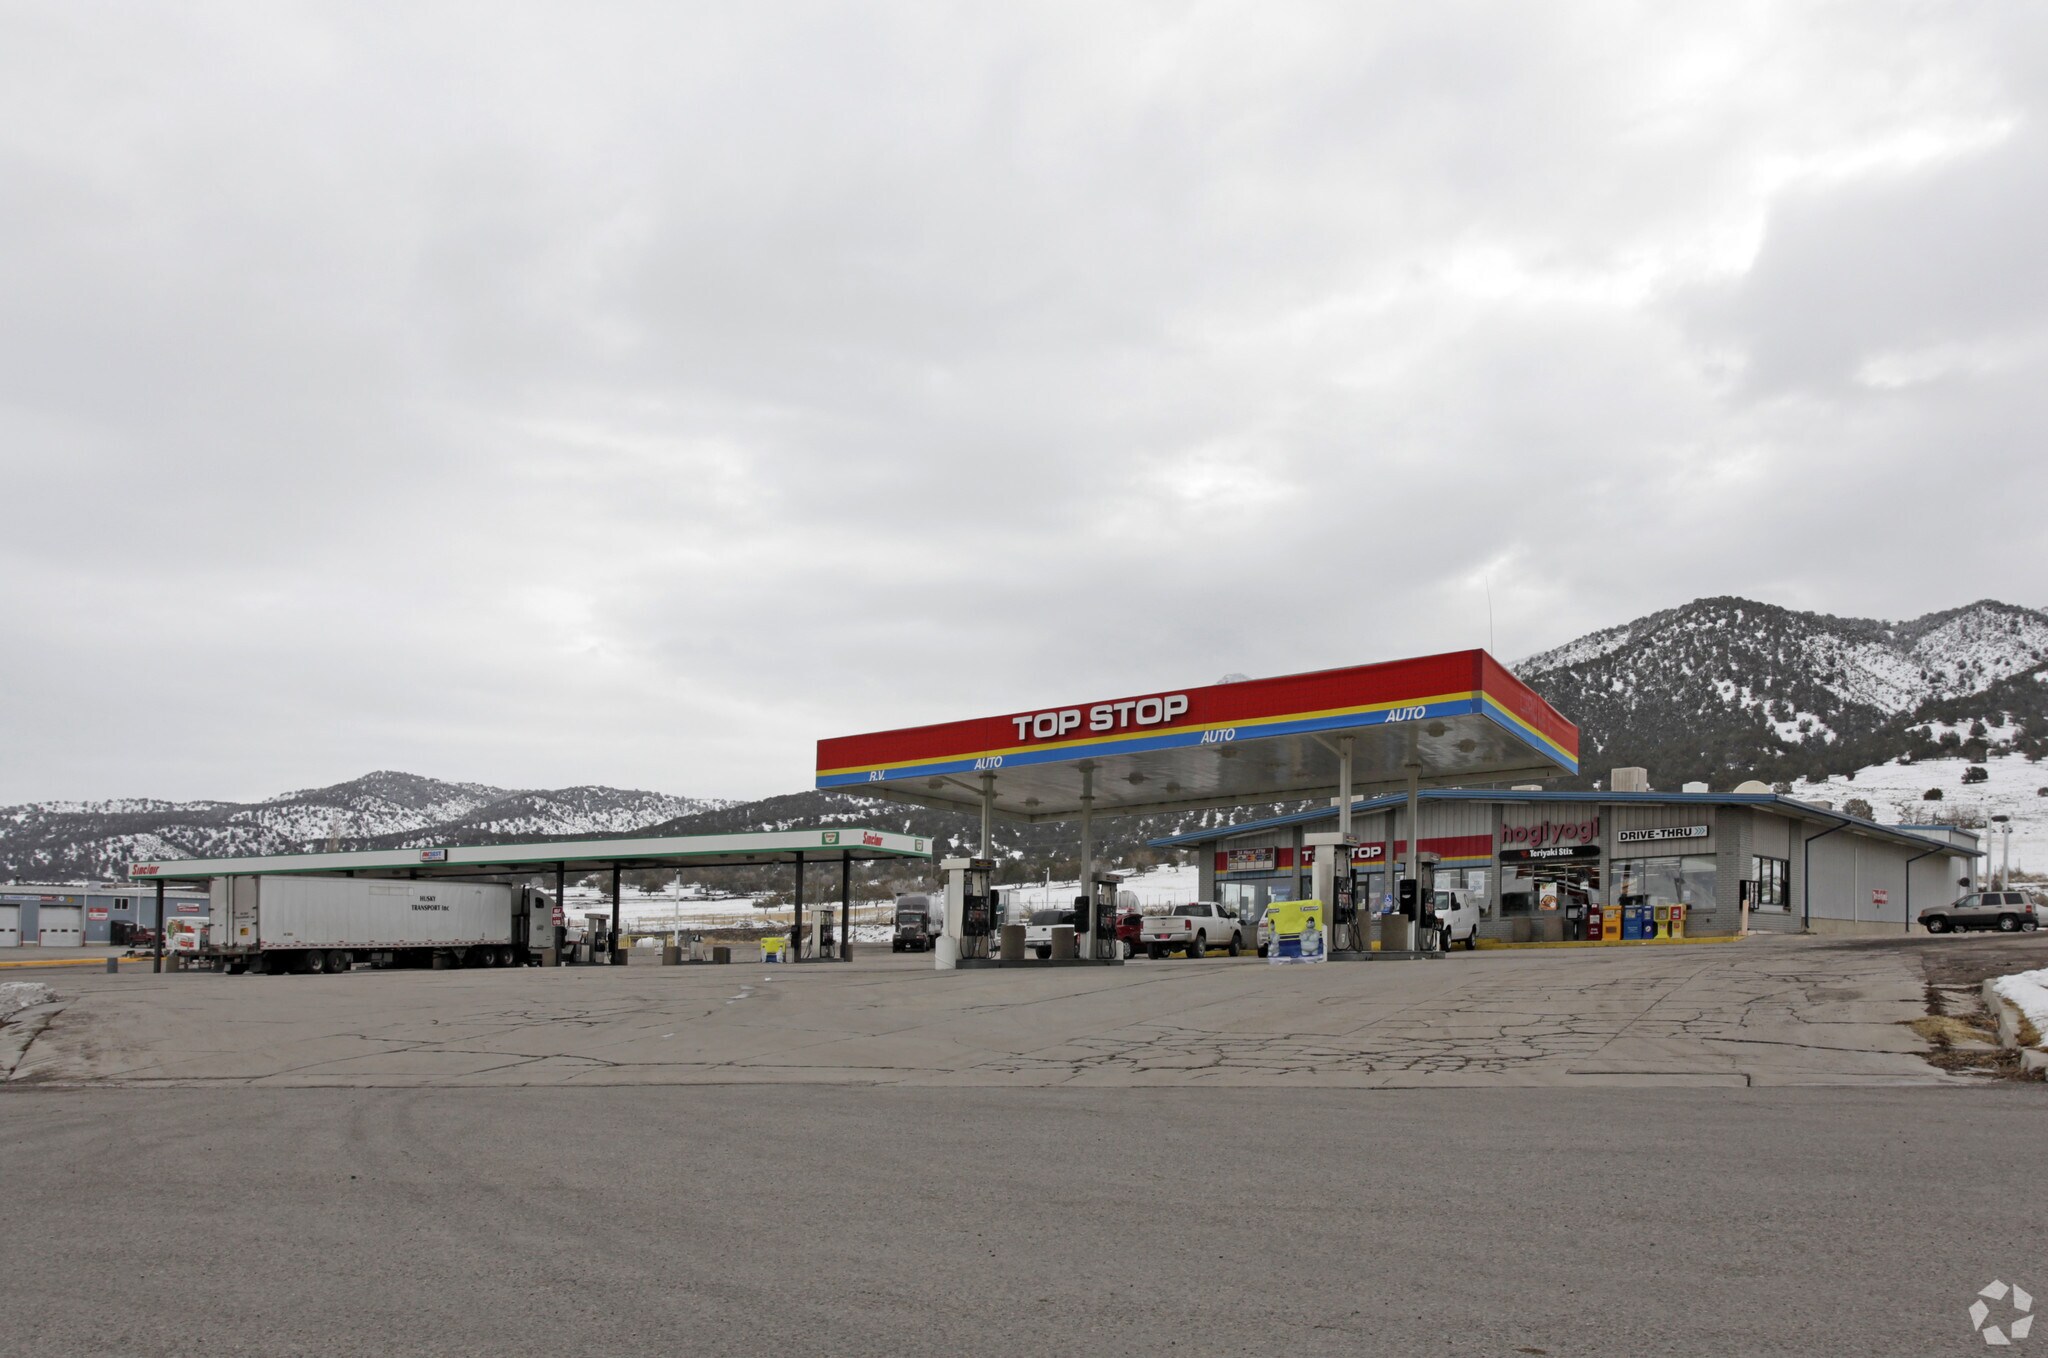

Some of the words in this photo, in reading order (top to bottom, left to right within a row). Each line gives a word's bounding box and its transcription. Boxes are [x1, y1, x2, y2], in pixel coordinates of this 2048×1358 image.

[1012, 709, 1081, 741] TOP
[1089, 694, 1188, 731] STOP
[1384, 705, 1426, 723] AUTO
[1200, 728, 1236, 744] AUTO
[973, 755, 1003, 770] AUTO
[869, 769, 885, 782] R.V.
[1500, 820, 1548, 847] hogi
[1549, 816, 1600, 845] yogi
[1620, 827, 1692, 841] DRIVE-THRU
[1351, 846, 1382, 859] TOP
[1530, 849, 1558, 859] Teriyaki
[1558, 848, 1573, 856] Stix
[132, 864, 160, 875] Sinclair
